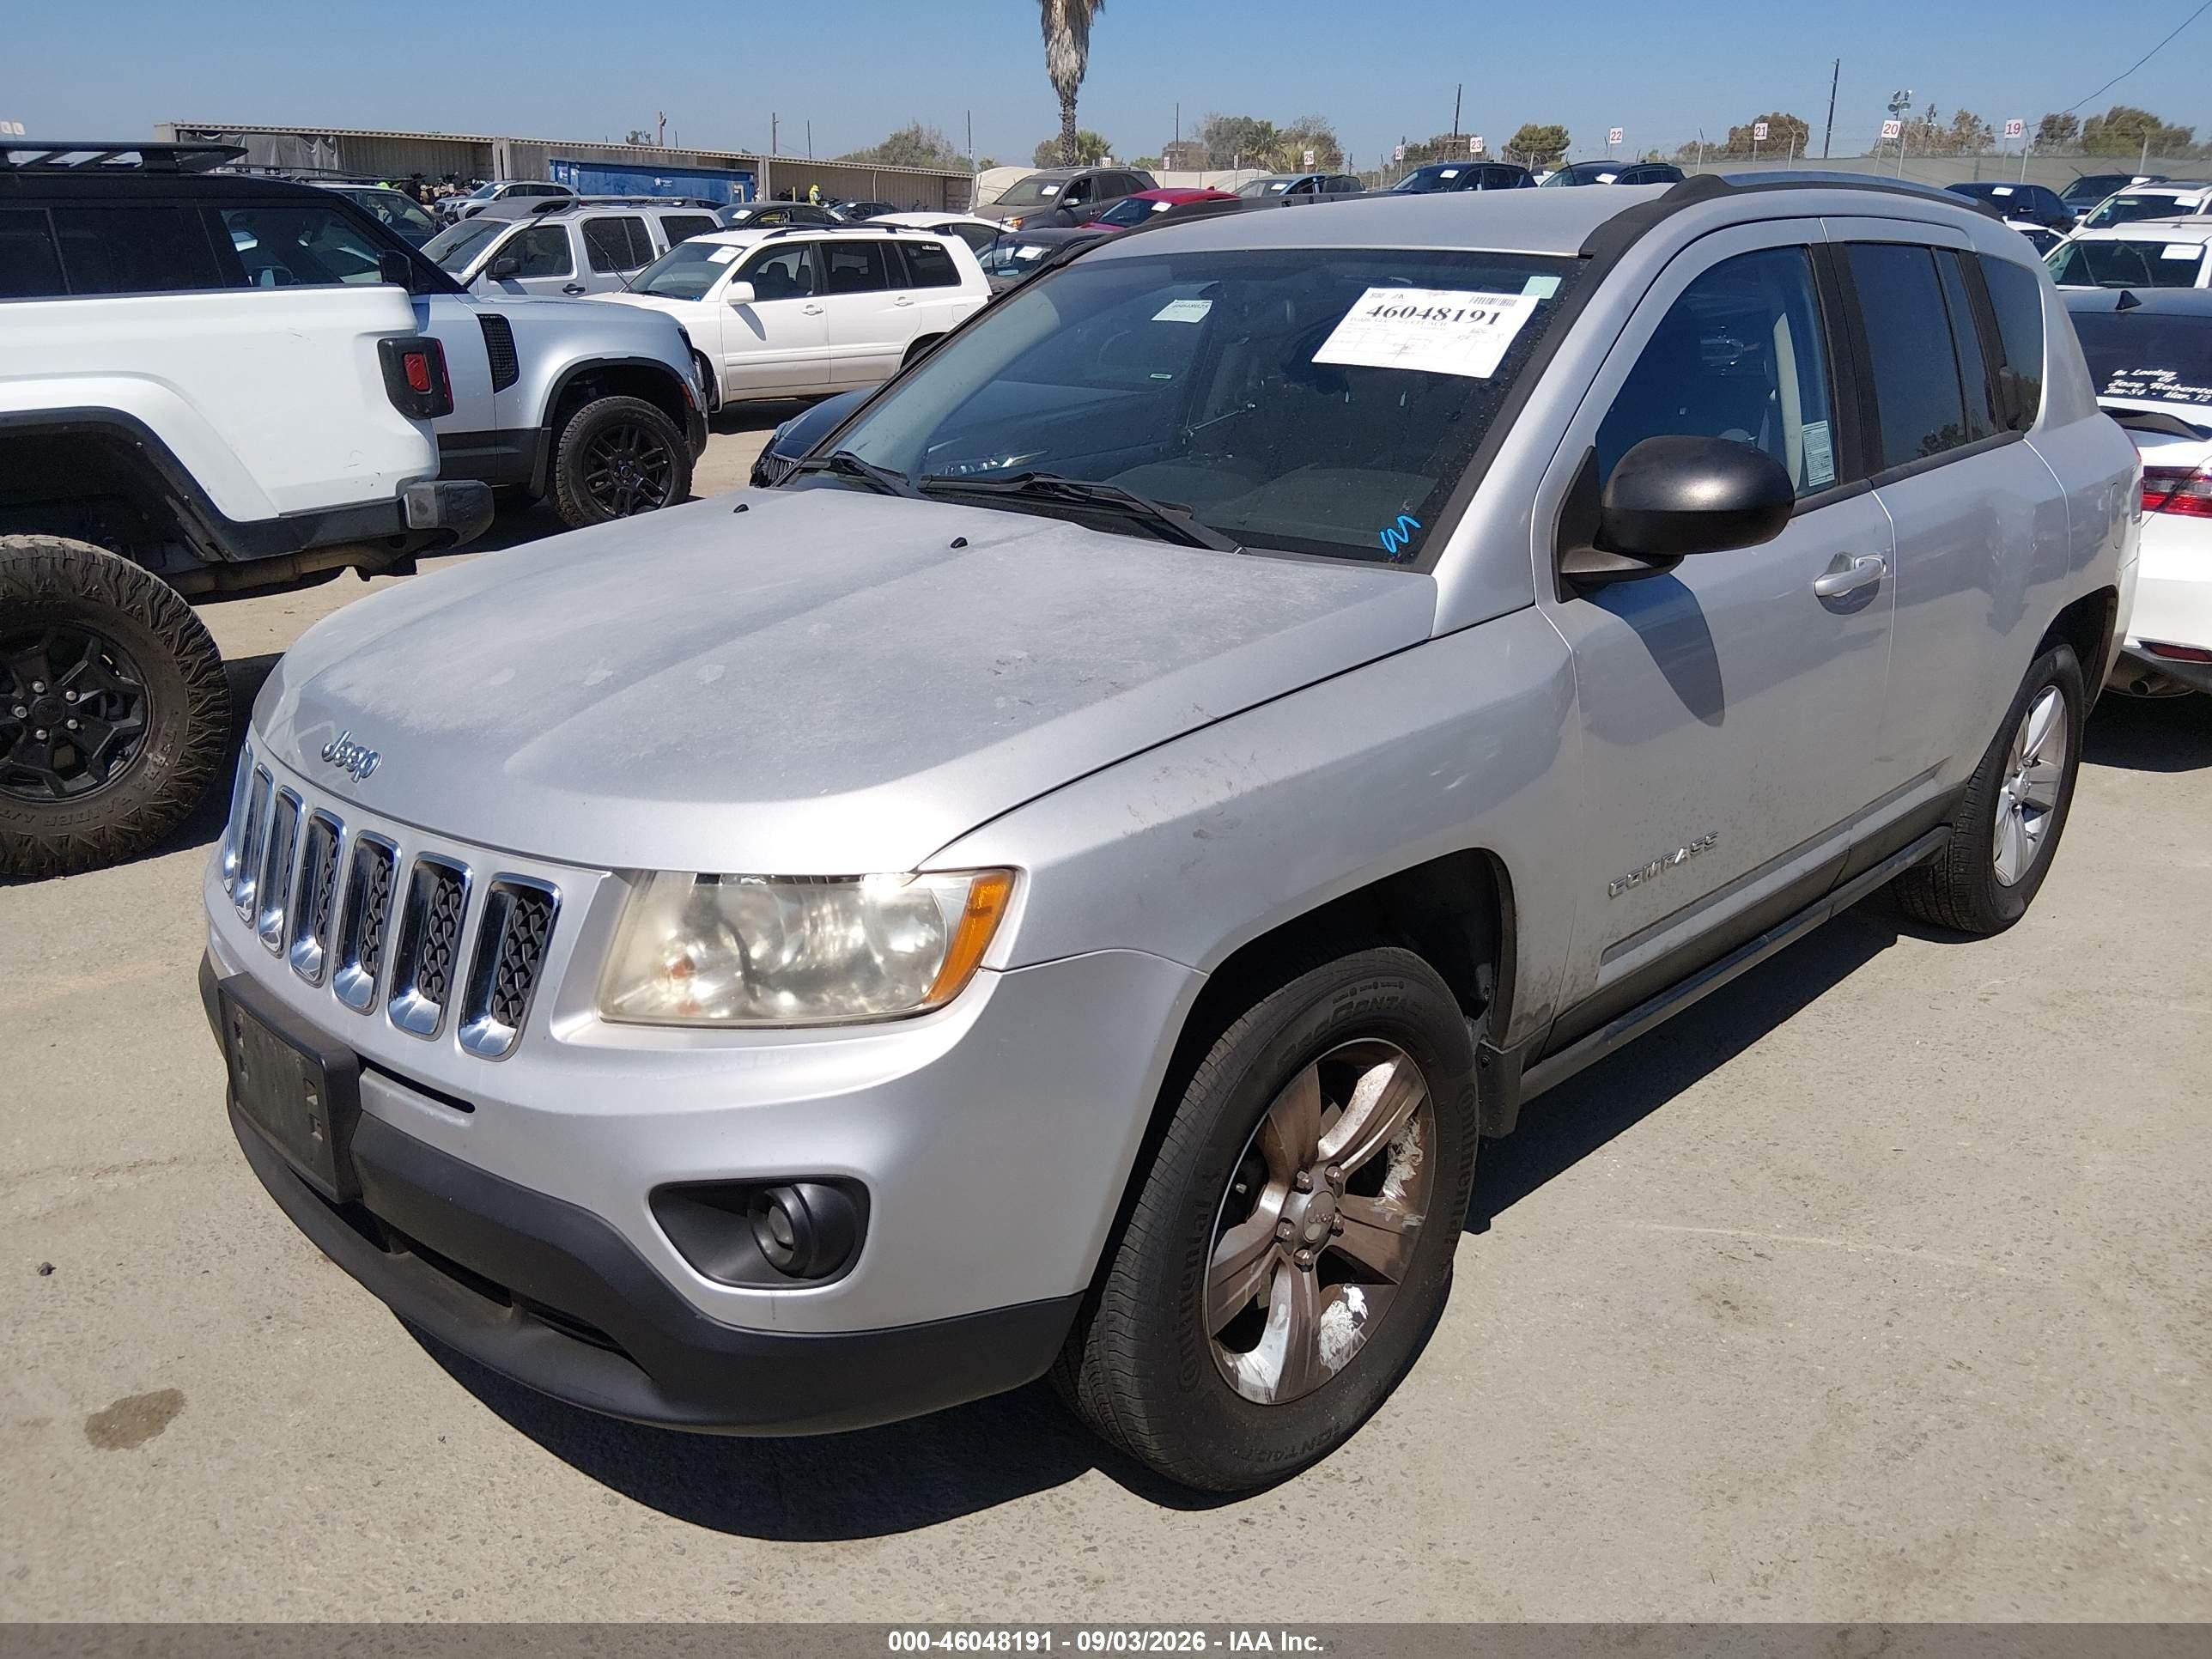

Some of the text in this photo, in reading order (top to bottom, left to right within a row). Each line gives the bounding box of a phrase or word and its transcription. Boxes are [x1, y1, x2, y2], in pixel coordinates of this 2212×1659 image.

[1754, 126, 1765, 137] 21
[1883, 124, 1899, 135] 20
[2006, 123, 2021, 135] 19
[1611, 131, 1622, 141] 22
[1471, 140, 1482, 149] 23
[1305, 153, 1313, 162] 25
[1366, 304, 1501, 325] 46048191
[2130, 368, 2178, 378] Loving
[2107, 379, 2212, 394] Jose Roberto
[321, 730, 380, 783] Jeep
[1608, 831, 1717, 898] COMPASS
